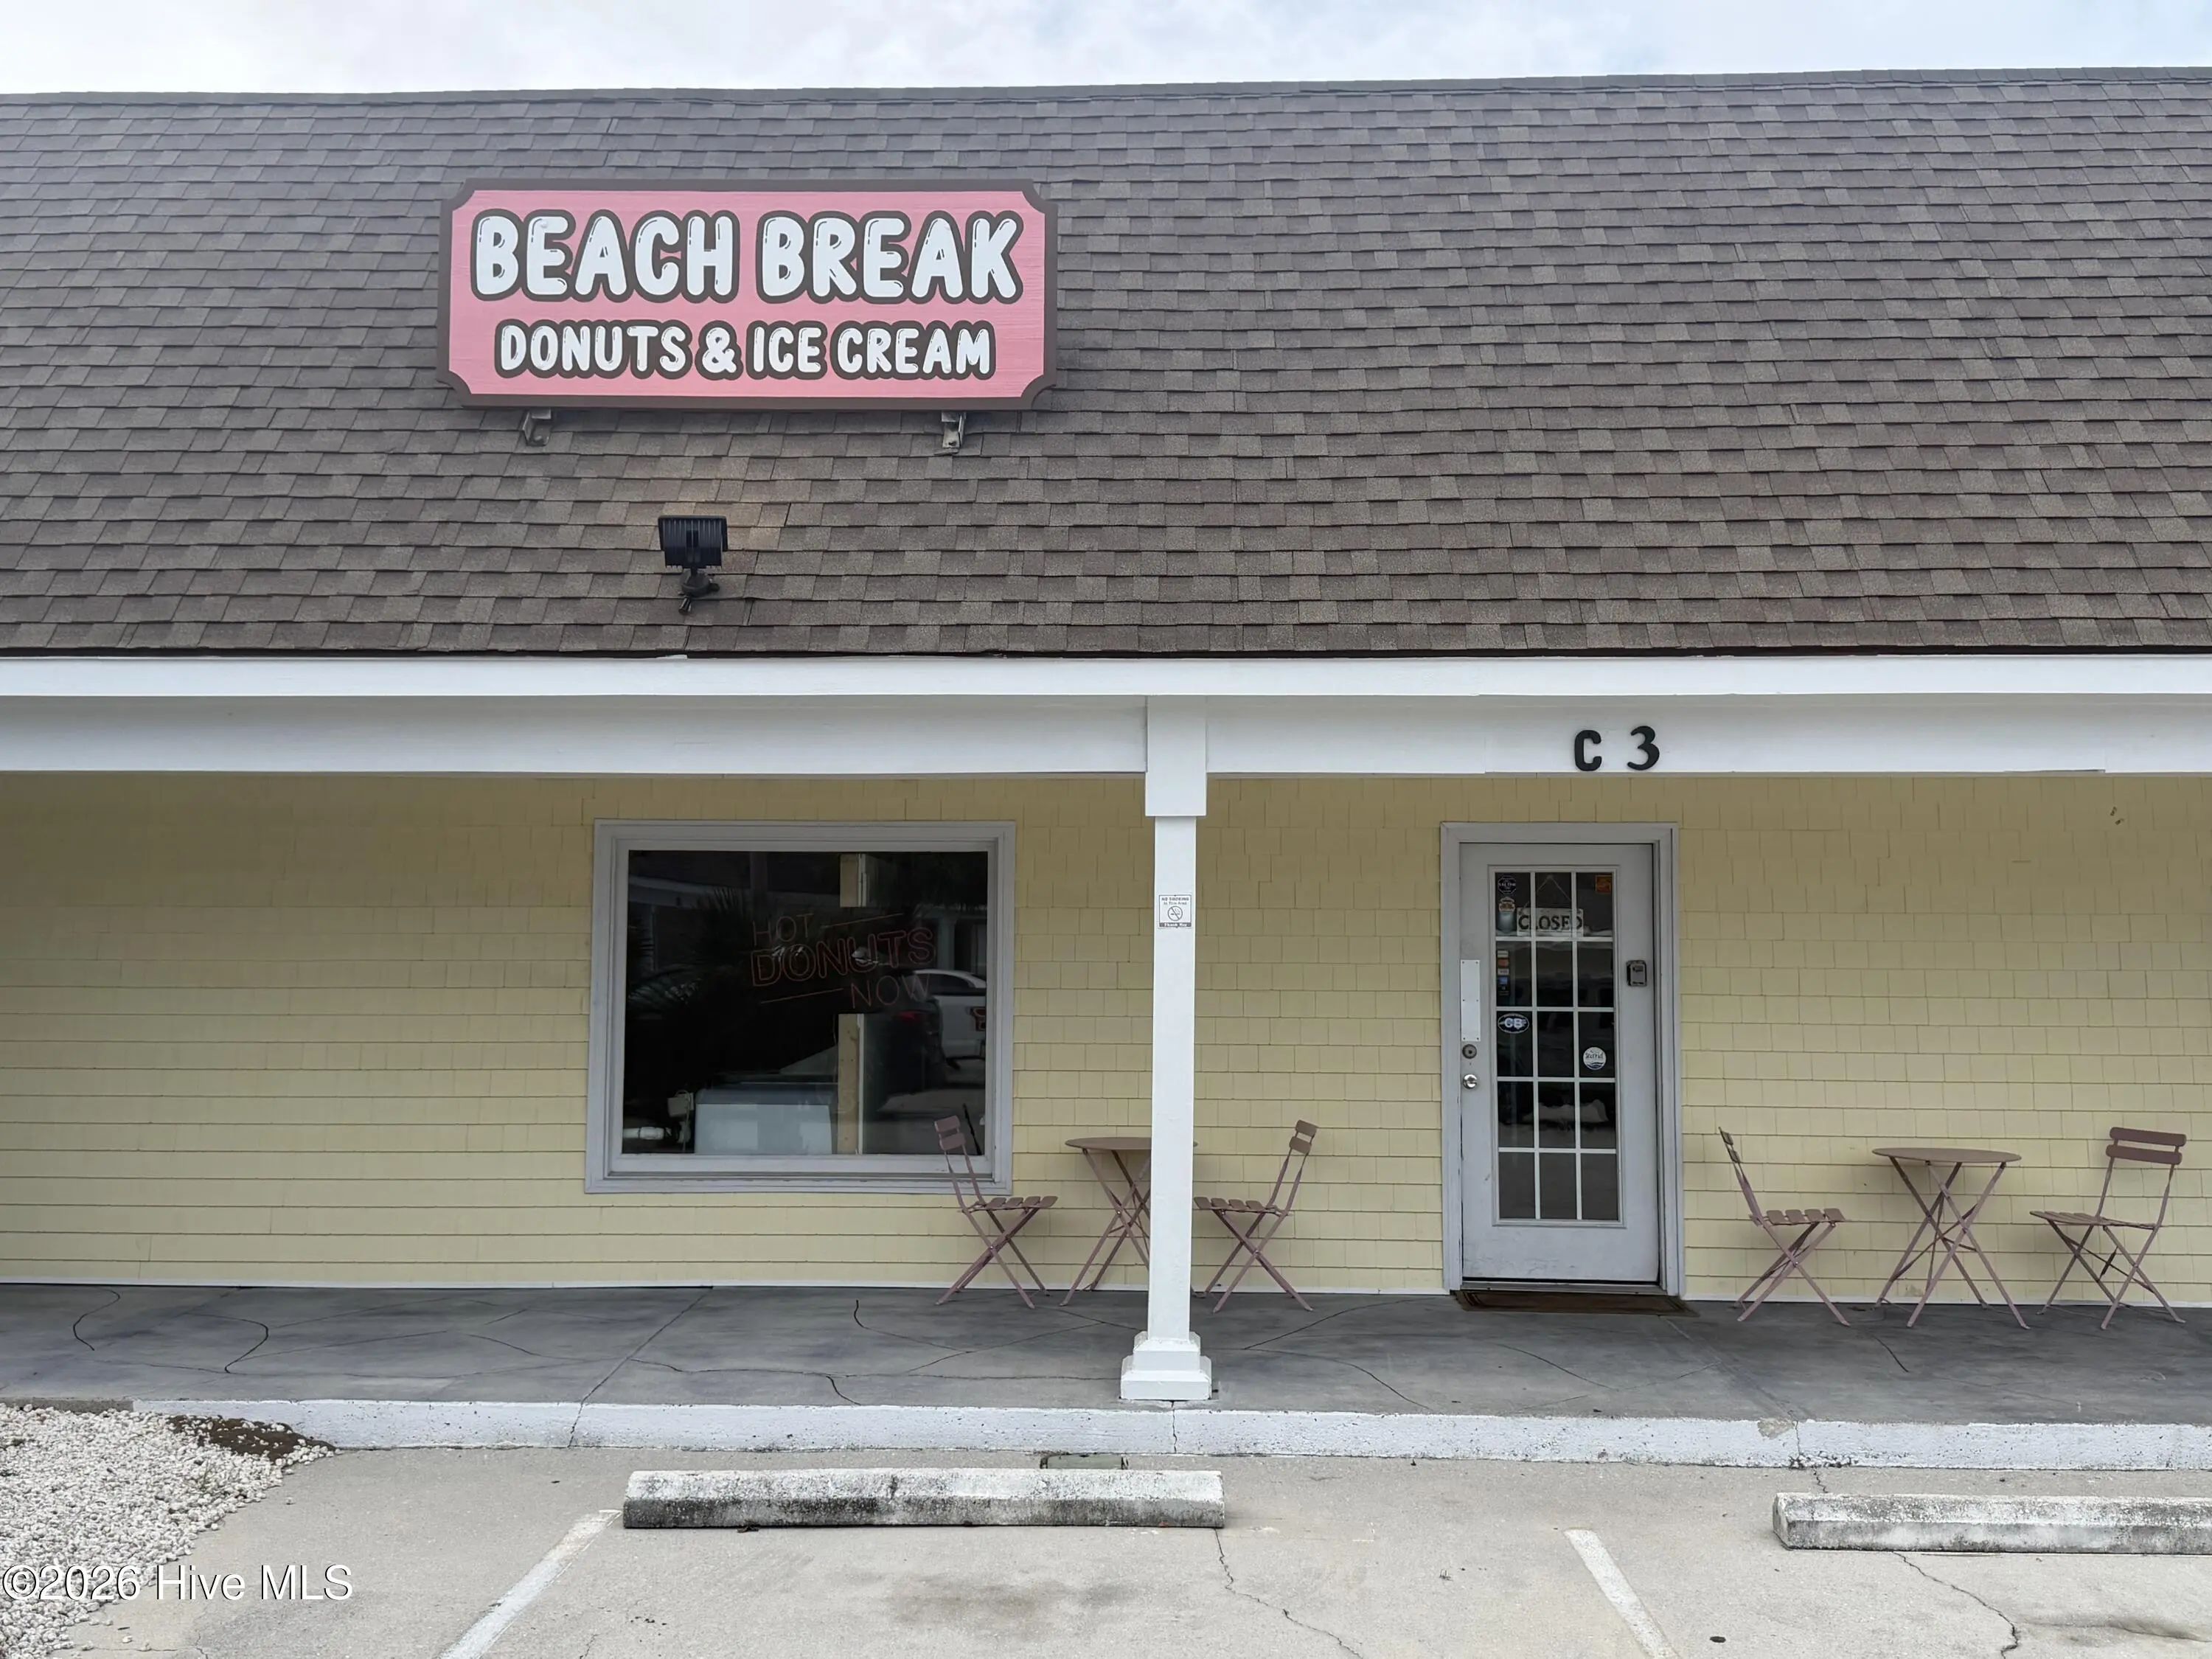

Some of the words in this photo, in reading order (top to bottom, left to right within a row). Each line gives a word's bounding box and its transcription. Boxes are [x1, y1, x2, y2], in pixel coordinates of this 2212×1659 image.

[473, 214, 735, 297] BEACH
[761, 216, 1019, 299] BREAK
[499, 324, 686, 373] DONUTS
[701, 326, 737, 374] &
[752, 327, 822, 373] ICE
[837, 327, 990, 375] CREAM
[1574, 729, 1602, 771] C
[1627, 725, 1660, 771] 3
[751, 912, 815, 946] HOT
[1518, 914, 1583, 931] COSED
[750, 926, 936, 987] DONUTS
[849, 973, 931, 1009] NOW
